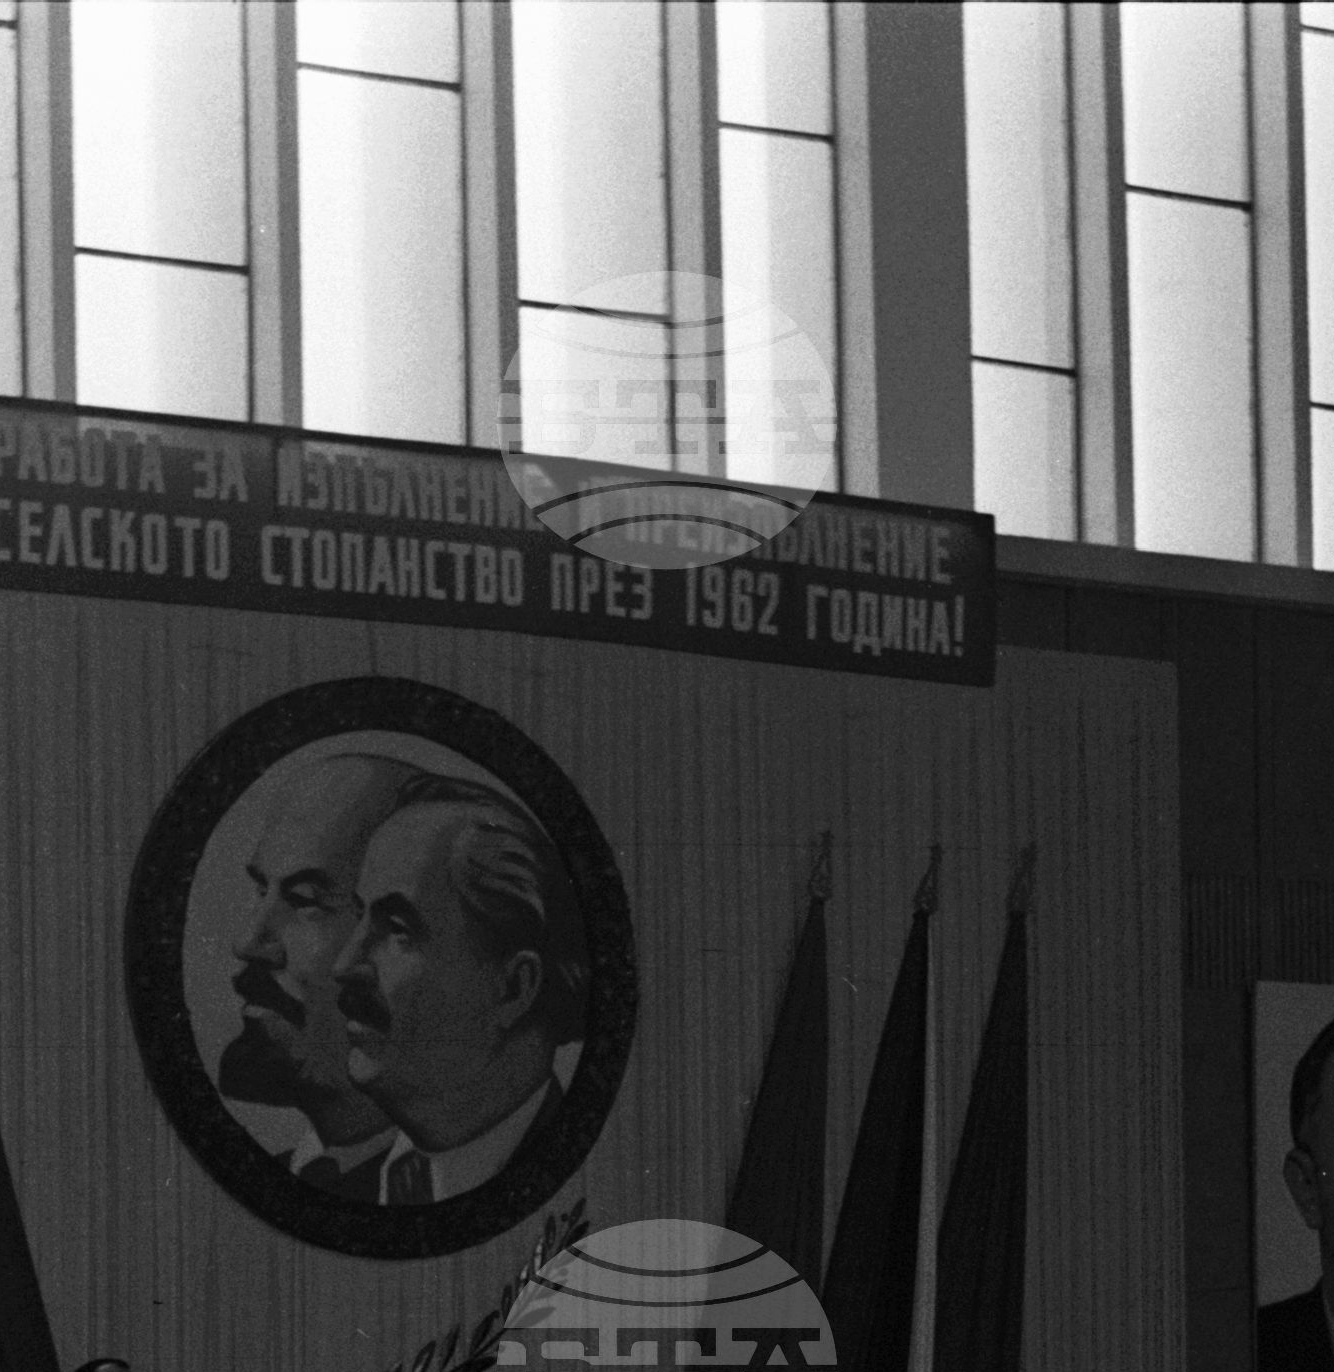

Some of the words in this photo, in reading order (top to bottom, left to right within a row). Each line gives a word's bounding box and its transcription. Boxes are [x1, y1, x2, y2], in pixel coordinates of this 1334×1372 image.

[192, 440, 250, 503] ЗА
[259, 524, 524, 608] СТОПАНСТВО
[550, 553, 653, 620] ПРЕЗ
[684, 561, 780, 636] 1962
[806, 583, 965, 657] ГОДИНА!
